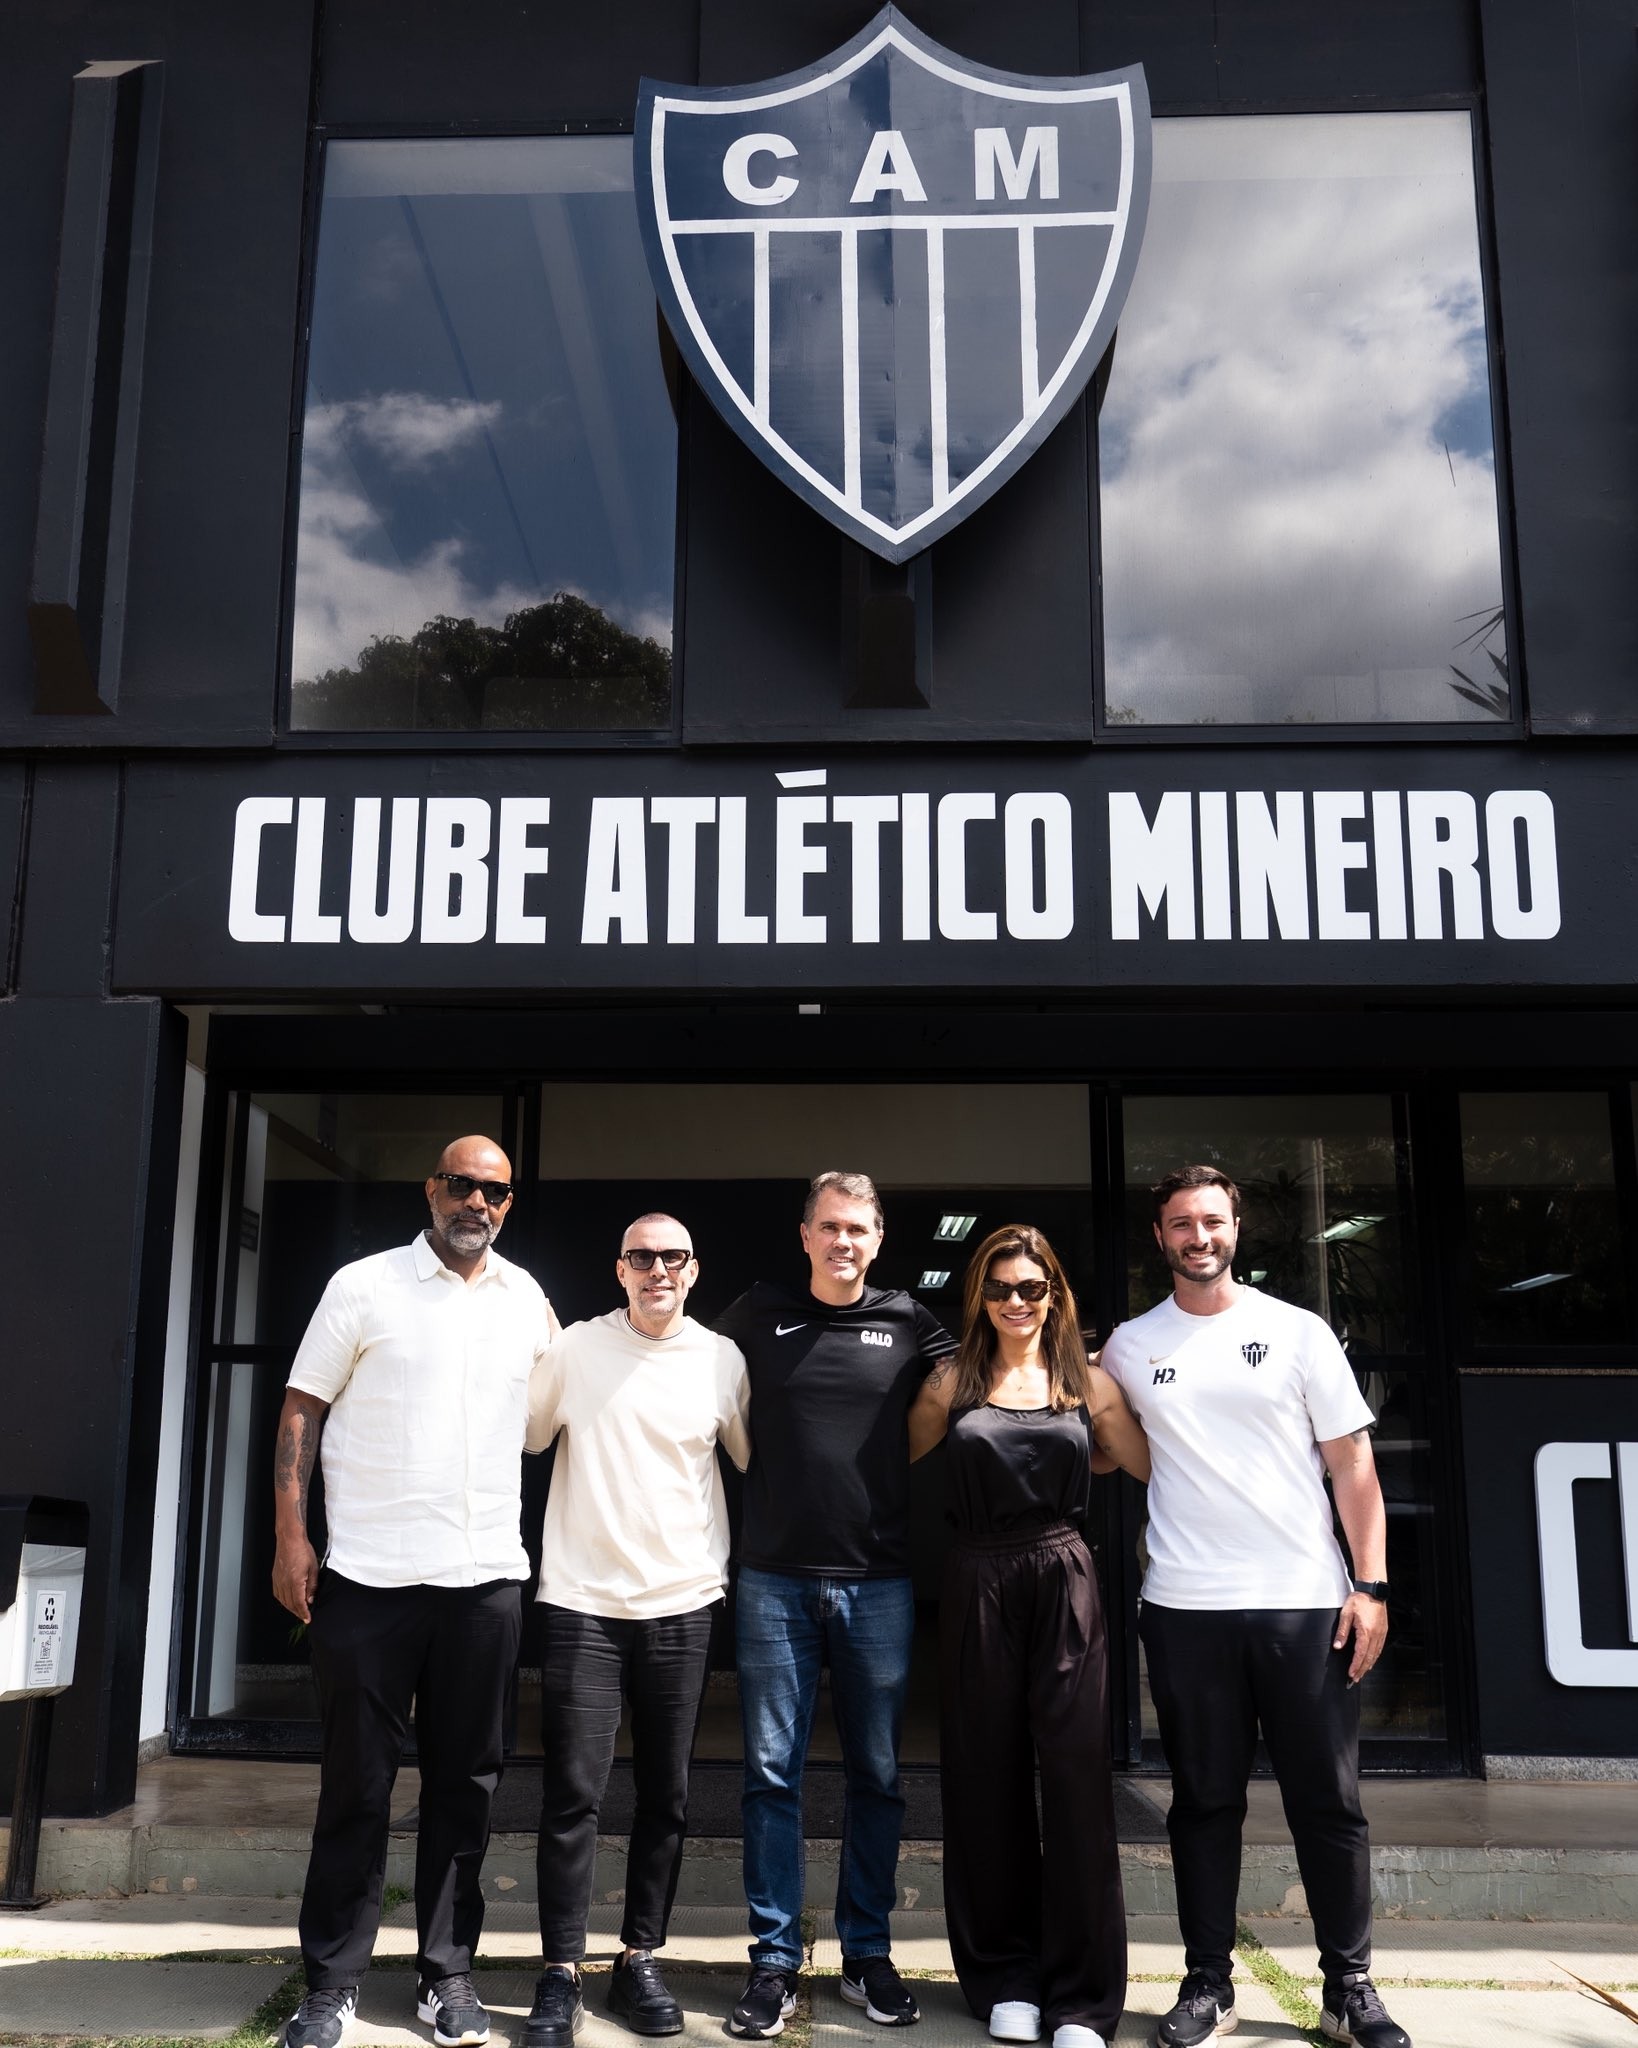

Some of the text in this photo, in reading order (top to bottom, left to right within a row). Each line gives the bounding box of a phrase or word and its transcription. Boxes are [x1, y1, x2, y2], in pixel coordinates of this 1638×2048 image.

[229, 768, 1562, 944] CLUBE ATLÉTICO MINEIRO
[860, 1330, 893, 1348] GALO
[1152, 1367, 1176, 1386] H2
